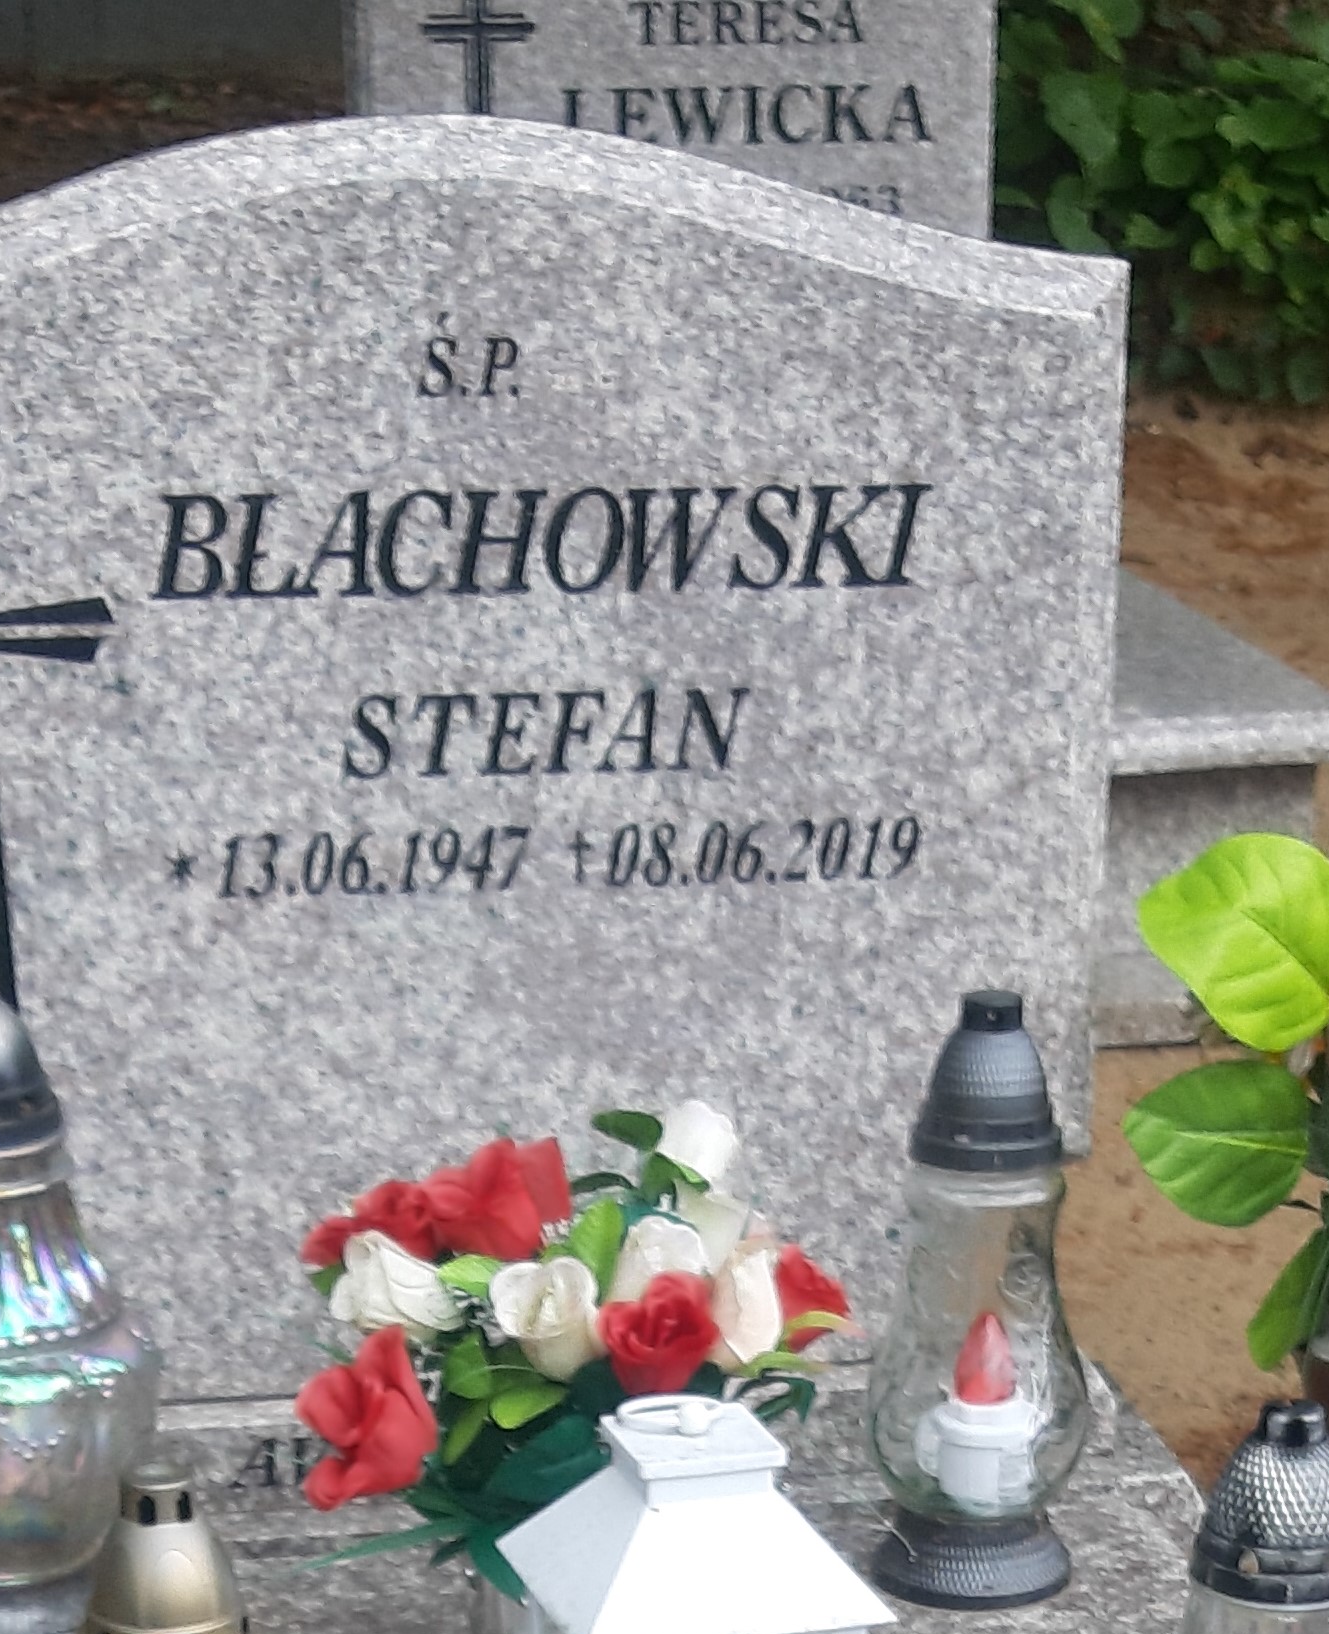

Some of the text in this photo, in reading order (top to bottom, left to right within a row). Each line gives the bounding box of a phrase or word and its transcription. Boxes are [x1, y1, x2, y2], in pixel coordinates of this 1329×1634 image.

[635, 0, 863, 46] TERESA
[152, 482, 934, 601] BŁACHOWSKI
[341, 686, 751, 780] STEFAN
[219, 816, 922, 899] 13.06.1947 08.06.2019
